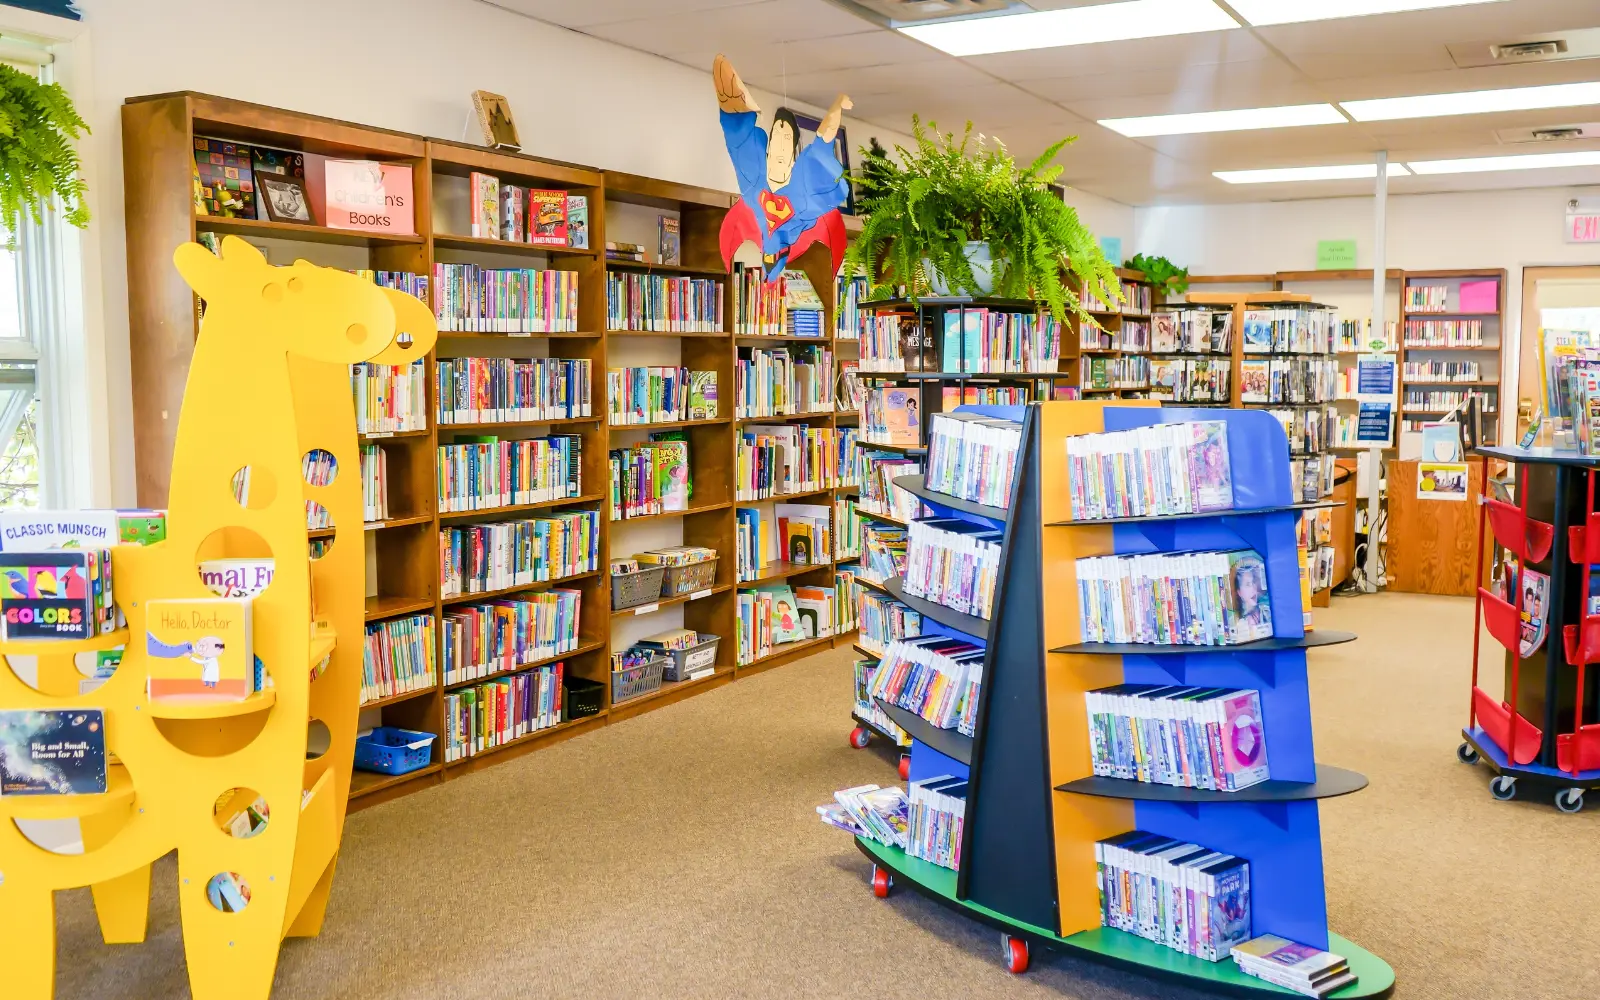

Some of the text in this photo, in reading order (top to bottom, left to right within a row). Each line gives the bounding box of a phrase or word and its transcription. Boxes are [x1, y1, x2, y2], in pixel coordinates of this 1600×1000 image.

[334, 189, 404, 207] Children's
[349, 211, 391, 227] Books
[1573, 216, 1600, 240] EXI
[913, 326, 927, 337] LAT
[908, 336, 932, 347] MESGE
[6, 523, 107, 540] CLASSIC MUNSCH
[6, 607, 82, 624] COLORS
[161, 609, 232, 630] Hello, Doctor
[56, 623, 83, 632] BOOK
[31, 741, 90, 752] Big and Small,
[32, 749, 84, 759] Room for All
